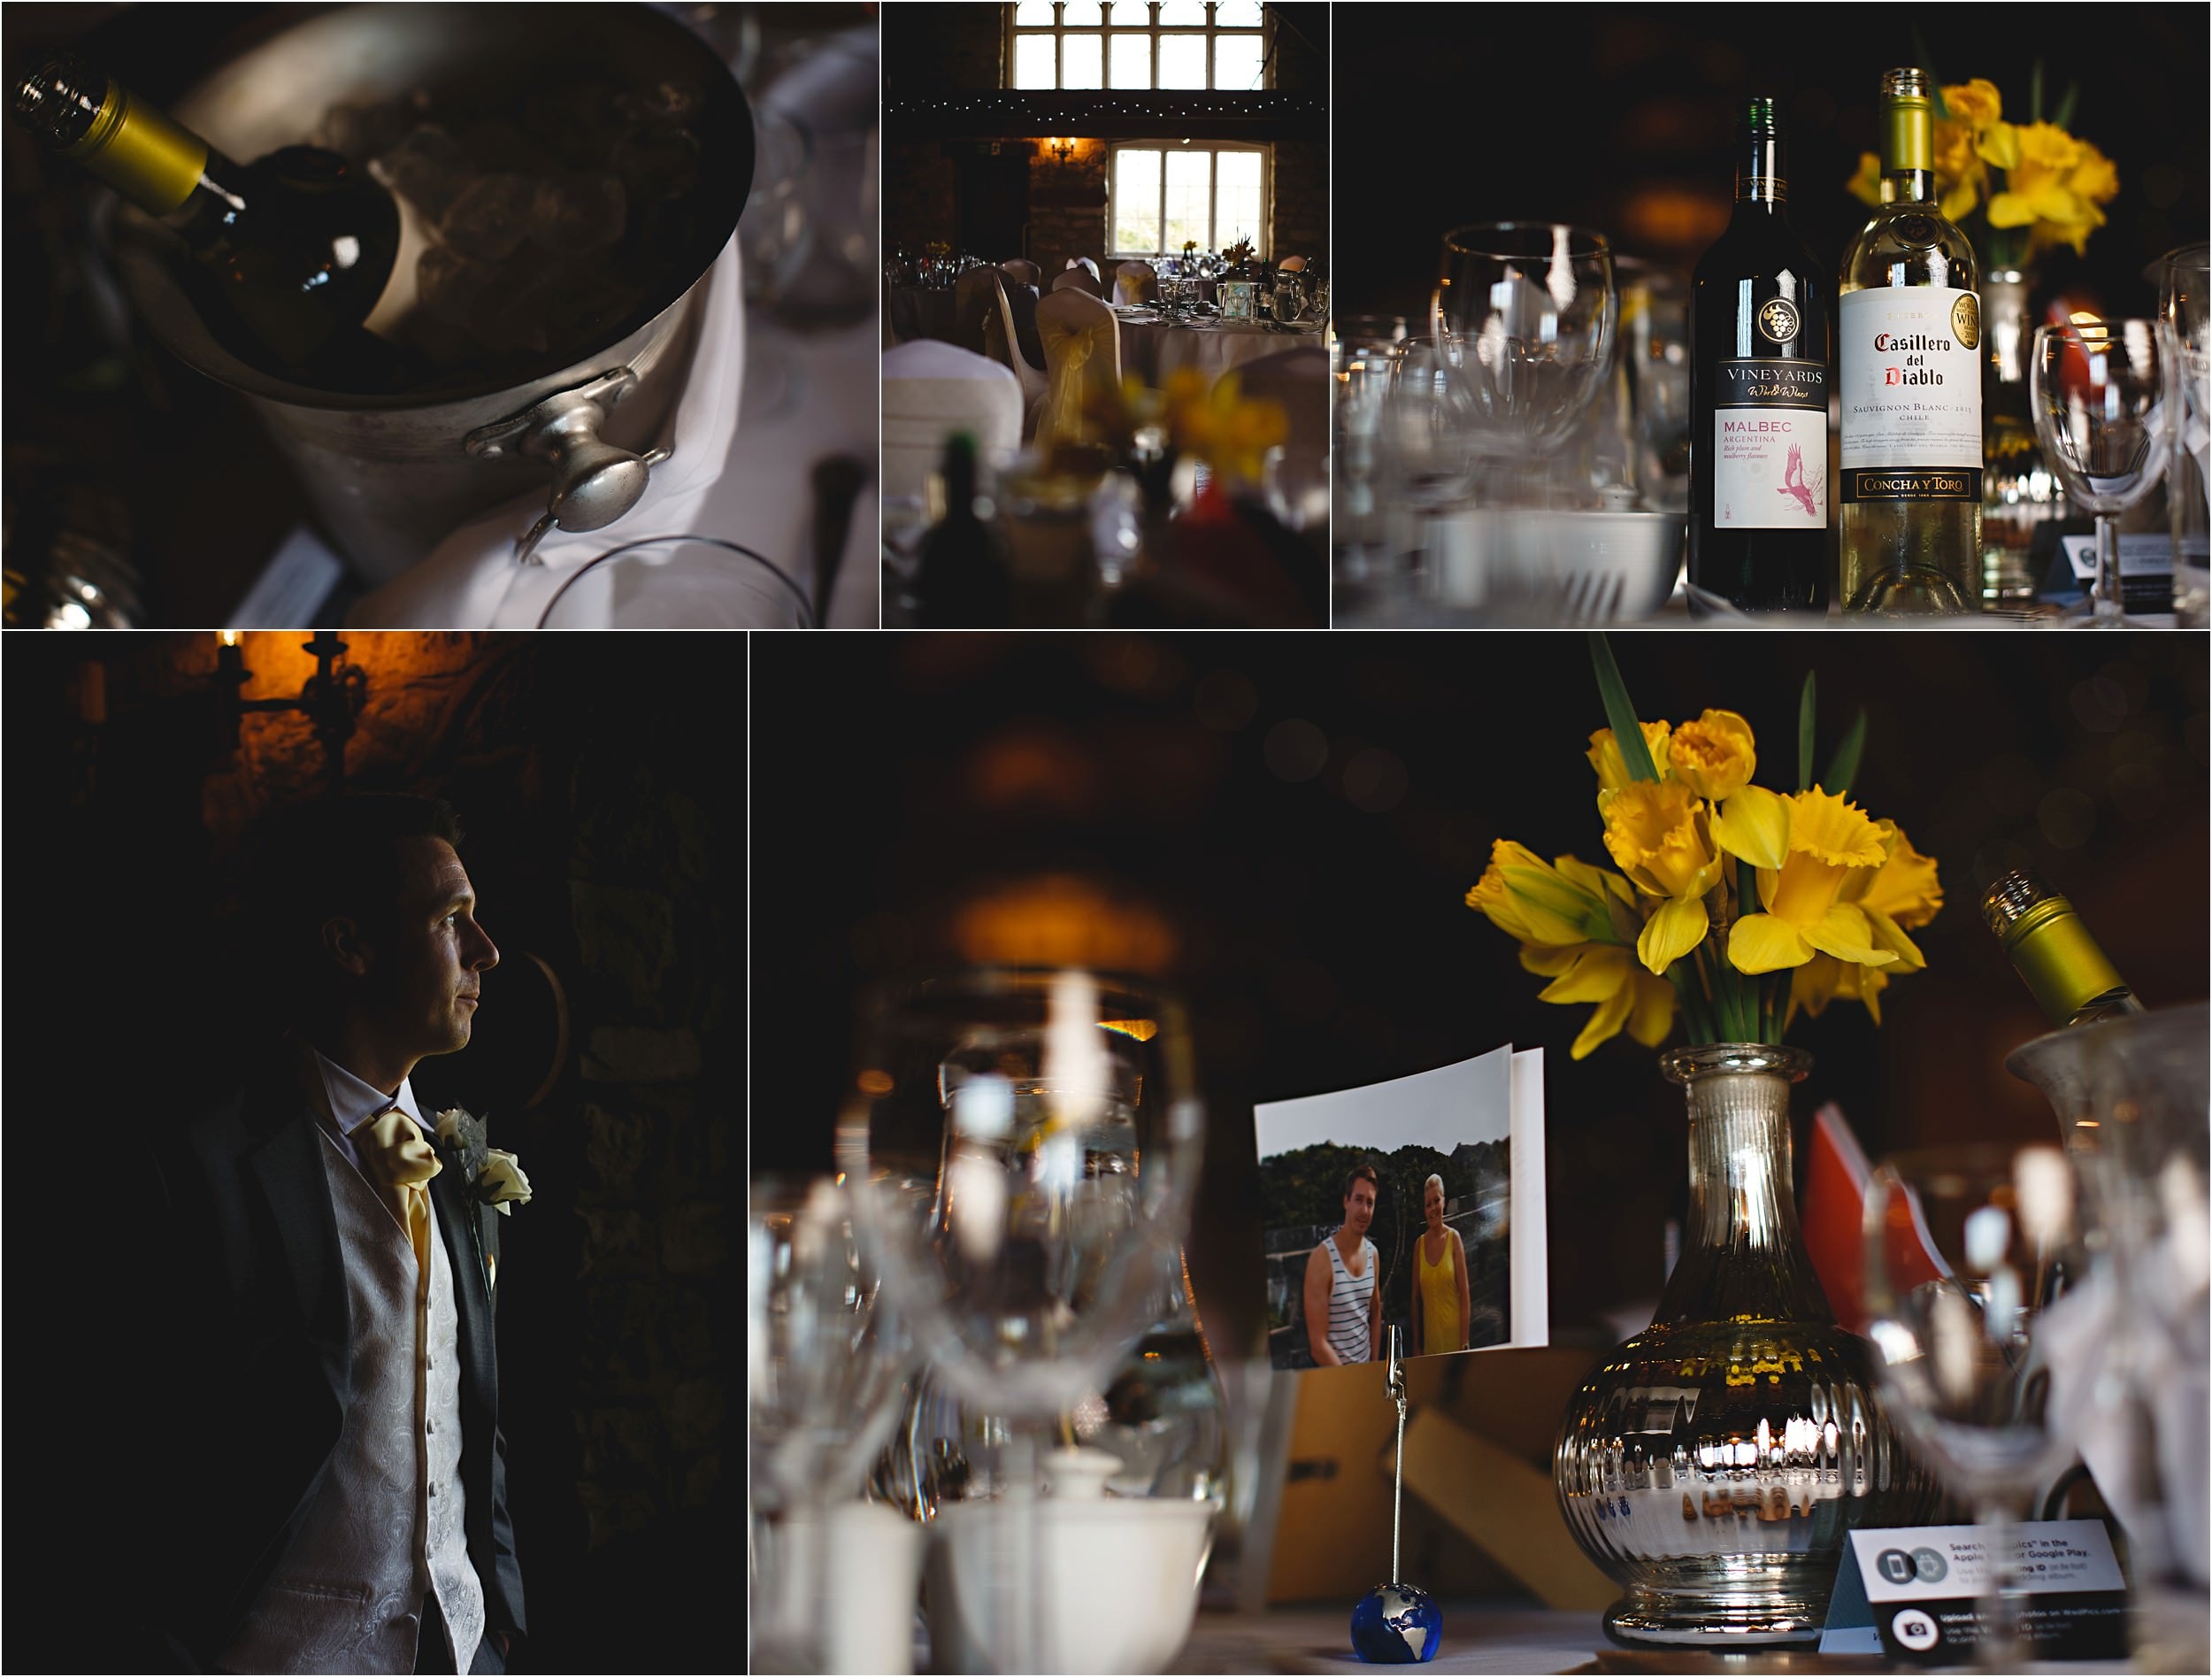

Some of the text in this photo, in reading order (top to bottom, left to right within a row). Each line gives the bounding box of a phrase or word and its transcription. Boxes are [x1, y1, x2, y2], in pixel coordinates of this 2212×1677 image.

[1956, 312, 1978, 327] WIN
[1874, 333, 1951, 352] Casillero
[1907, 354, 1924, 366] del
[1726, 368, 1824, 384] VINEYARDS
[1885, 367, 1944, 386] Diablo
[1724, 421, 1793, 433] MALBEC
[1863, 476, 1964, 492] CONCHA Y TORO
[2039, 1539, 2050, 1548] in
[2051, 1538, 2068, 1547] the
[2028, 1550, 2064, 1559] Google
[1939, 1612, 1975, 1623] Upload
